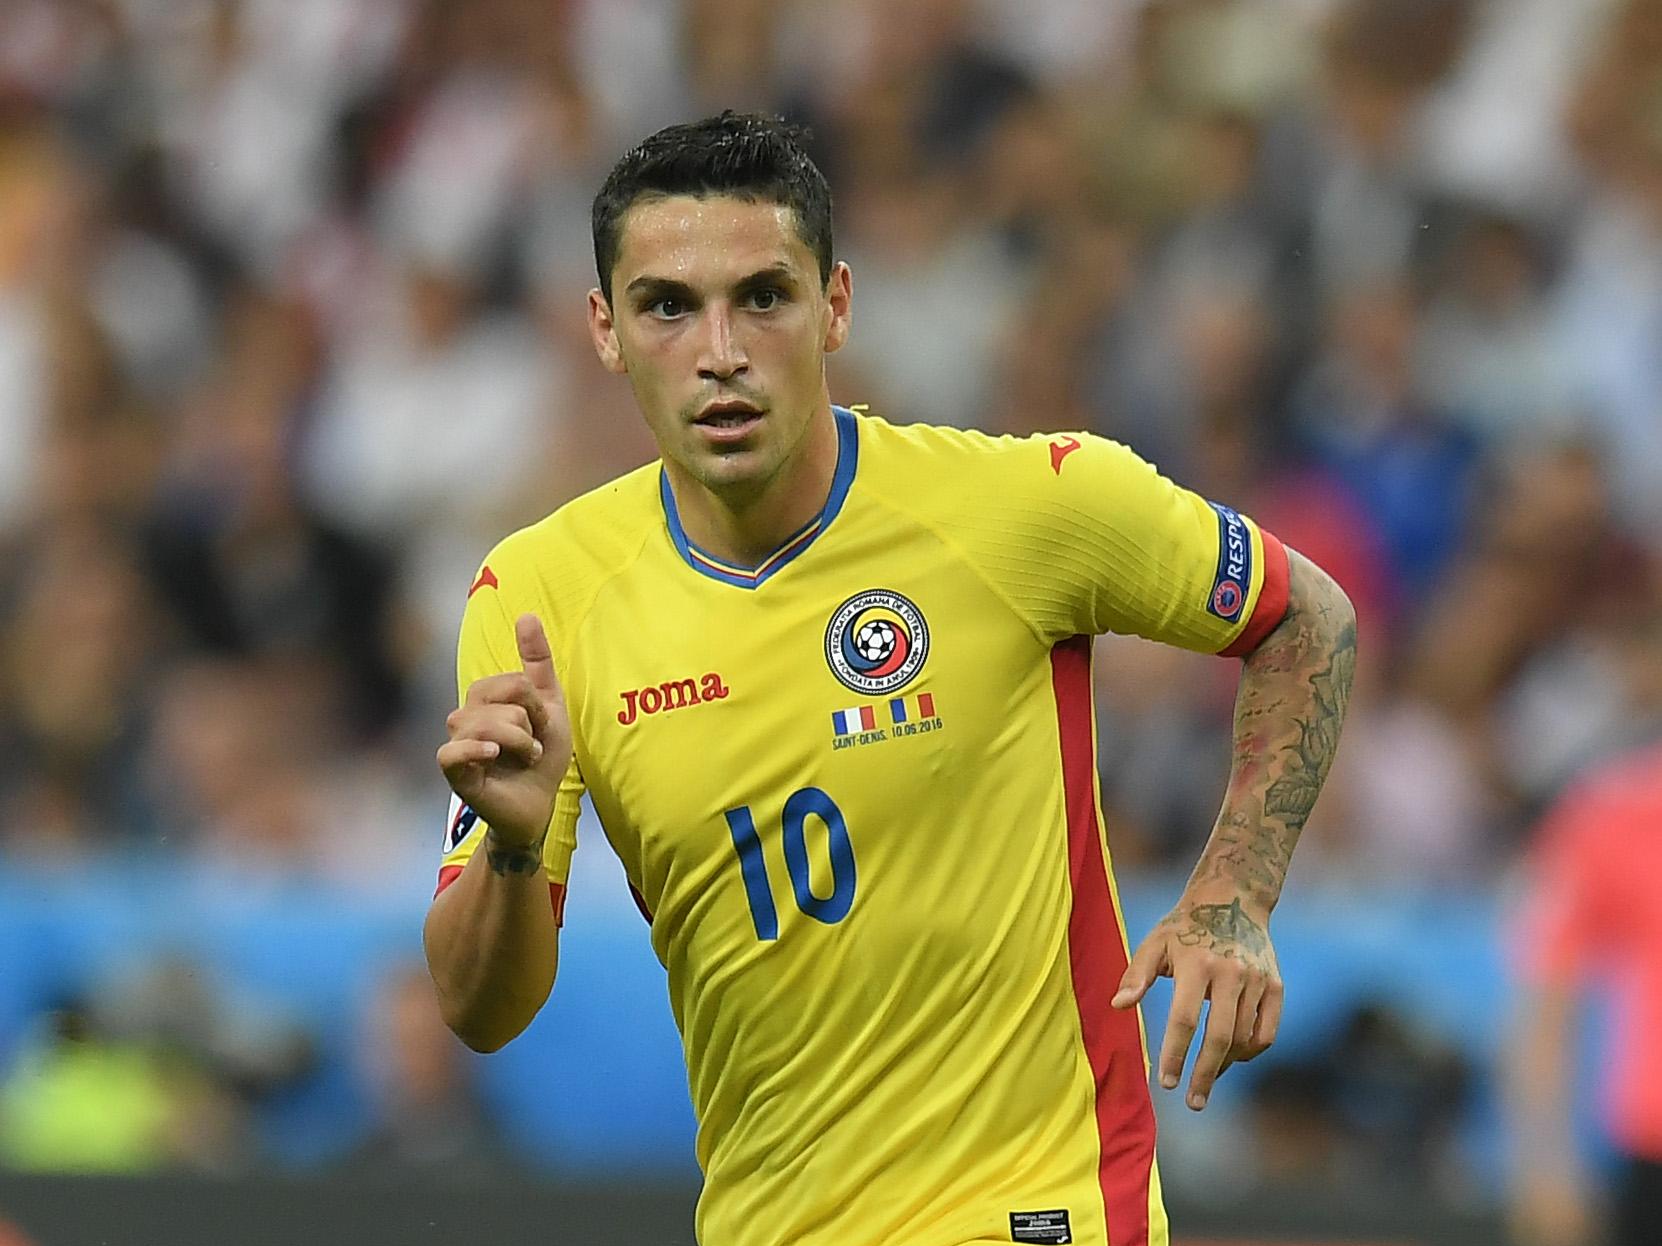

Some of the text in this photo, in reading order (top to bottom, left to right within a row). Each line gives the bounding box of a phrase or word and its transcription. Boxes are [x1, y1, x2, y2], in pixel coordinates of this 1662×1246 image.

[892, 601, 904, 611] DE
[903, 609, 921, 643] FOTBAL
[725, 787, 857, 940] 10
